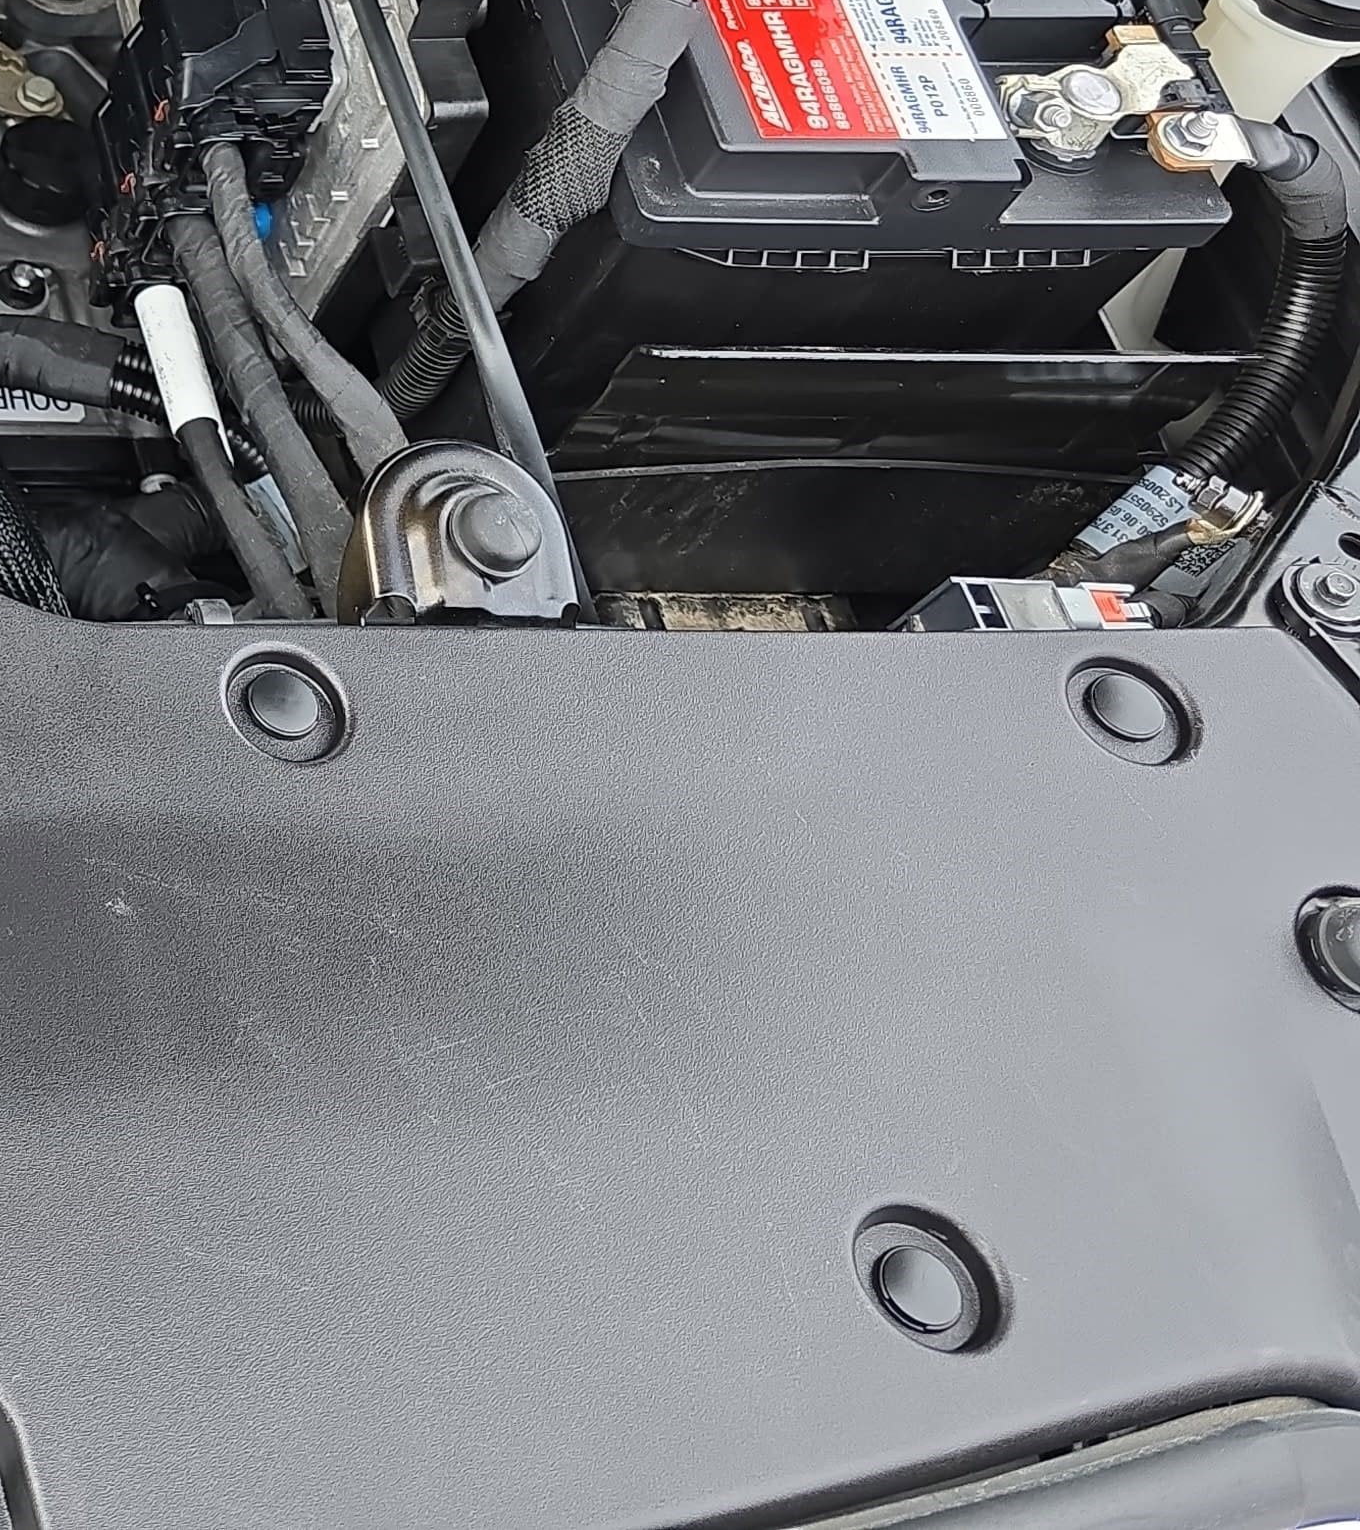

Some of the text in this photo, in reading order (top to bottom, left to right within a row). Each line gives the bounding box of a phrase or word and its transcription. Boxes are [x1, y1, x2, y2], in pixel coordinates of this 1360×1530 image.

[928, 8, 951, 41] 006860
[737, 42, 784, 128] ACDelco
[763, 12, 829, 129] 94RAGMHR
[918, 75, 949, 117] P012P
[958, 78, 985, 116] 006860
[890, 66, 932, 133] 94RAGMHR
